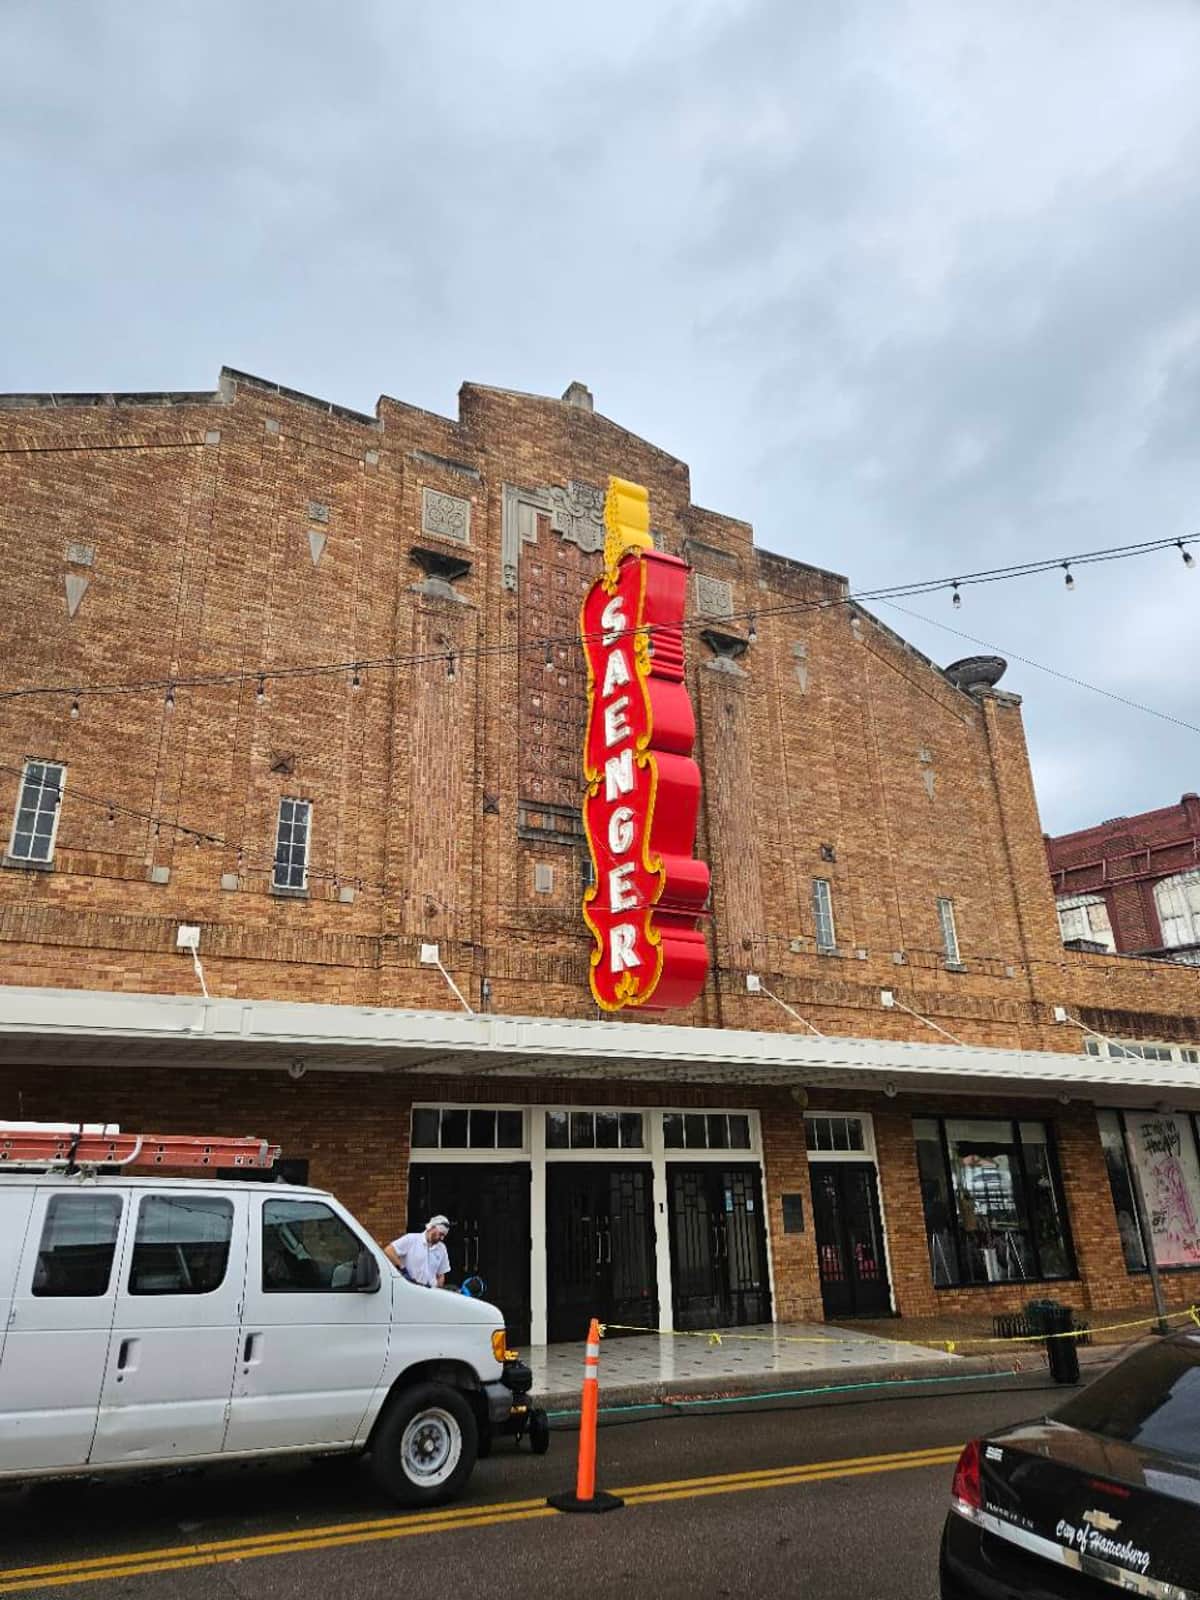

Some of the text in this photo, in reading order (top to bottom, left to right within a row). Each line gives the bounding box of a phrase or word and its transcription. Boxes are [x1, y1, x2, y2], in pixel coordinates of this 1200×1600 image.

[601, 596, 641, 973] SAENGER
[1055, 1519, 1076, 1544] City
[1076, 1522, 1091, 1554] of
